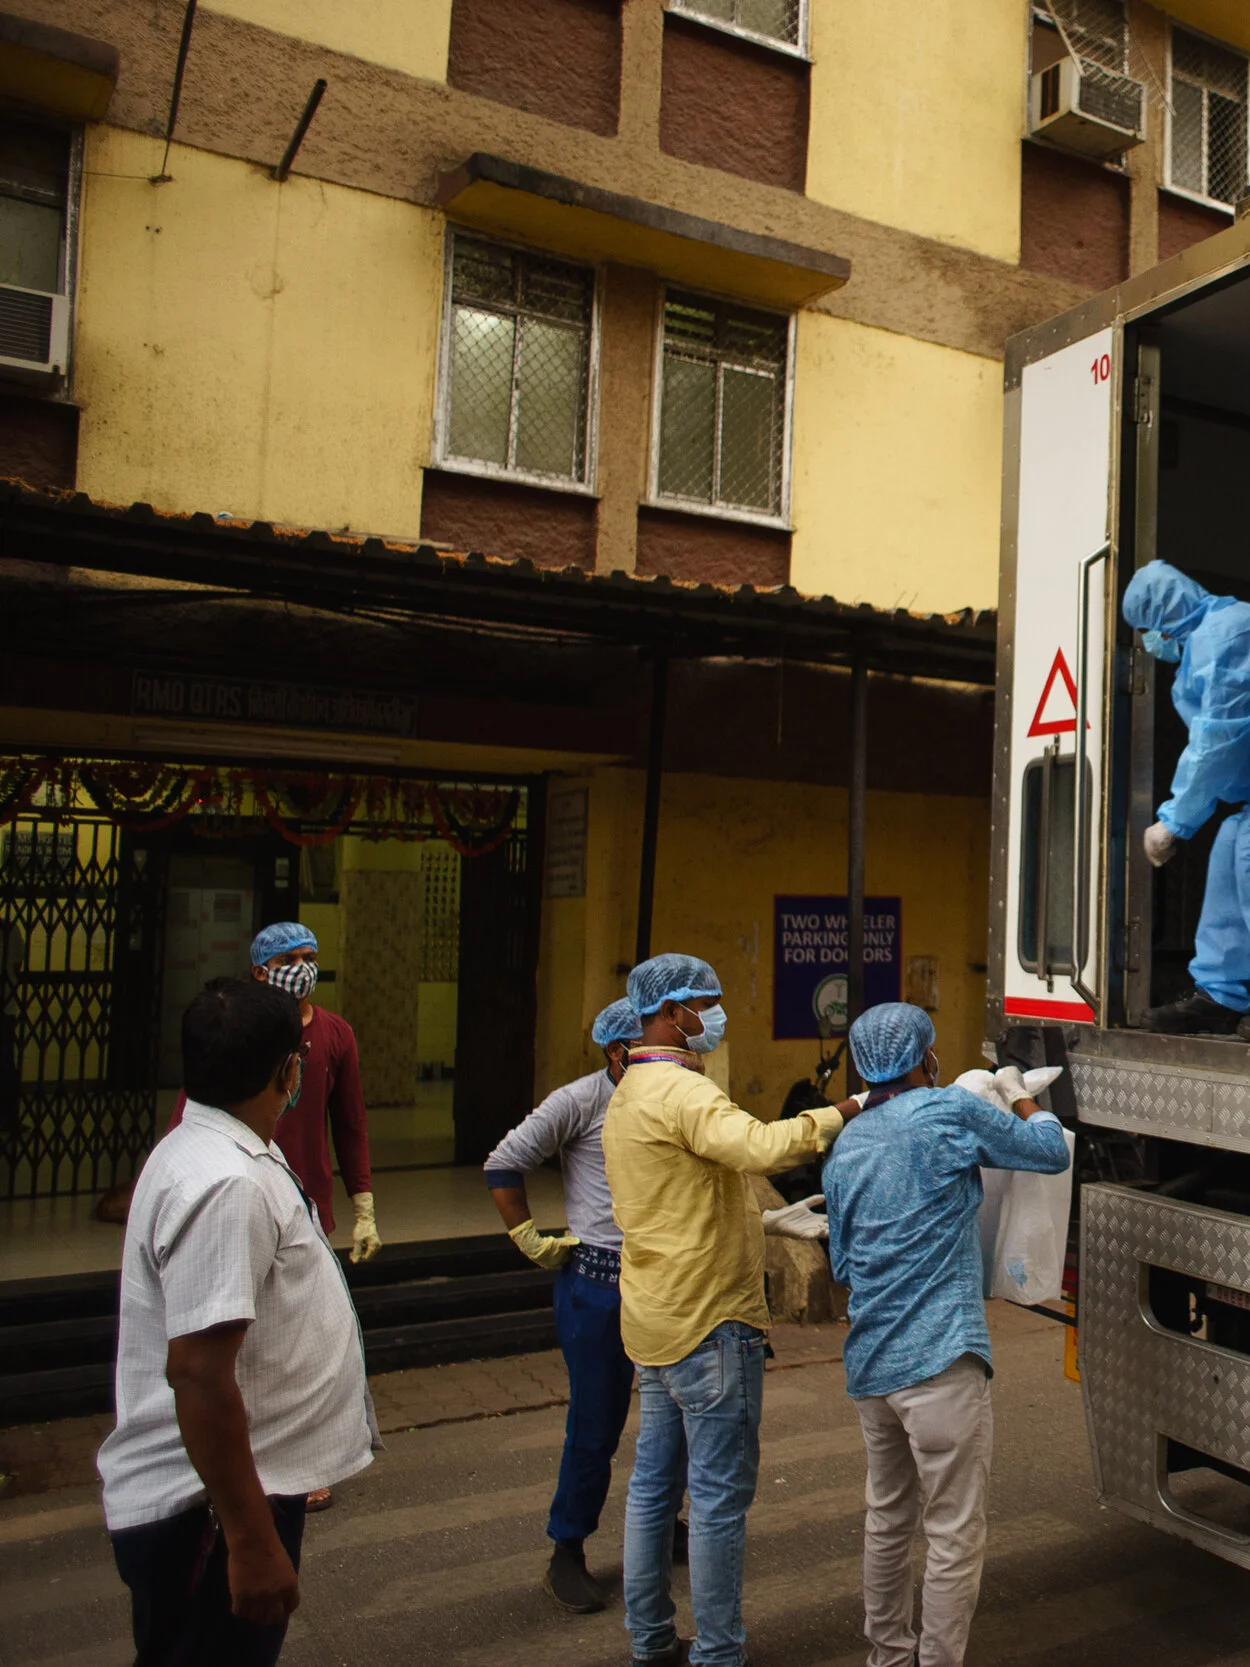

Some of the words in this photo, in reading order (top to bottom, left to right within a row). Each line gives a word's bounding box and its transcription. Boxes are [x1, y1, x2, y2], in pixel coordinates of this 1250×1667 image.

[1091, 354, 1110, 385] 10
[136, 676, 183, 712] RMO
[189, 682, 242, 717] QTRS
[780, 914, 820, 930] TWO
[824, 914, 896, 930] WHELER
[863, 931, 894, 946] NLY
[784, 948, 816, 964] FOR
[820, 948, 892, 964] DOORS
